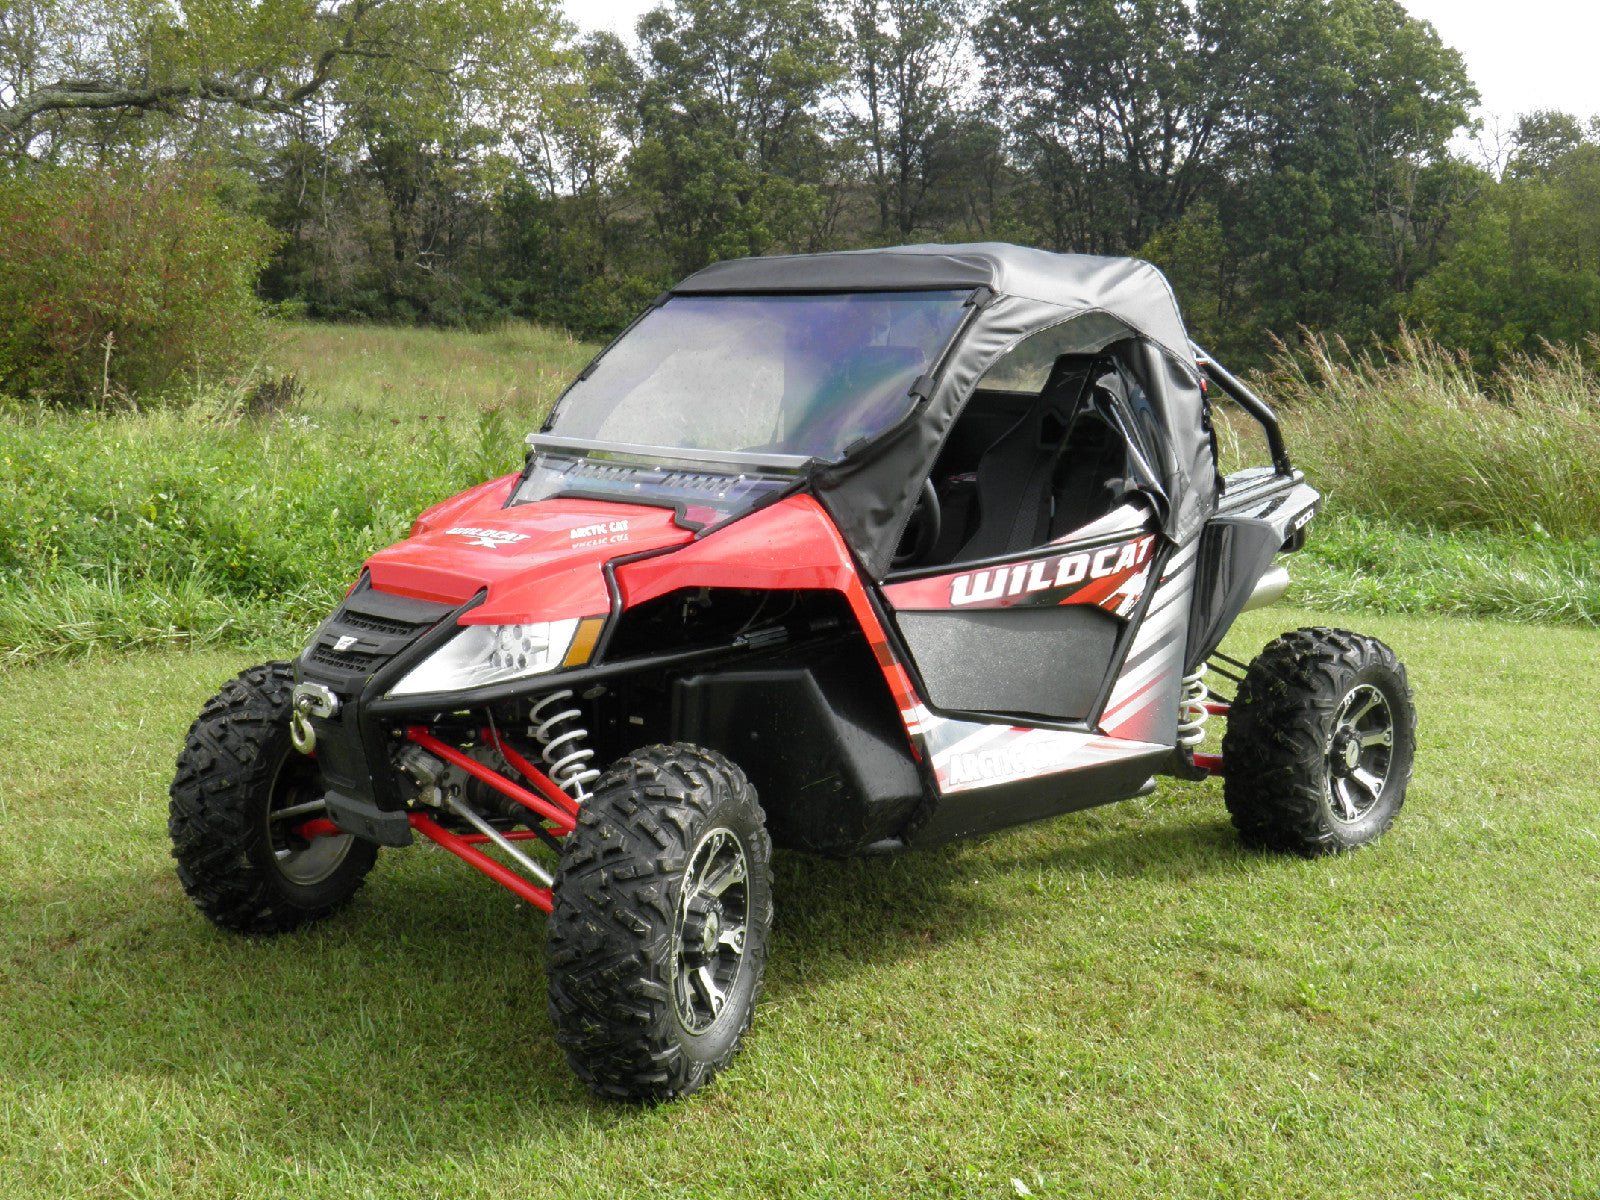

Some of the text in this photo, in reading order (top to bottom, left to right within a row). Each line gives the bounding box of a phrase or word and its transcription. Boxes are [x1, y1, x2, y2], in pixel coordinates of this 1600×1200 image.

[444, 527, 532, 542] WILDCAT
[570, 519, 629, 539] ARCTIC CAT
[949, 534, 1156, 606] WILDCAT
